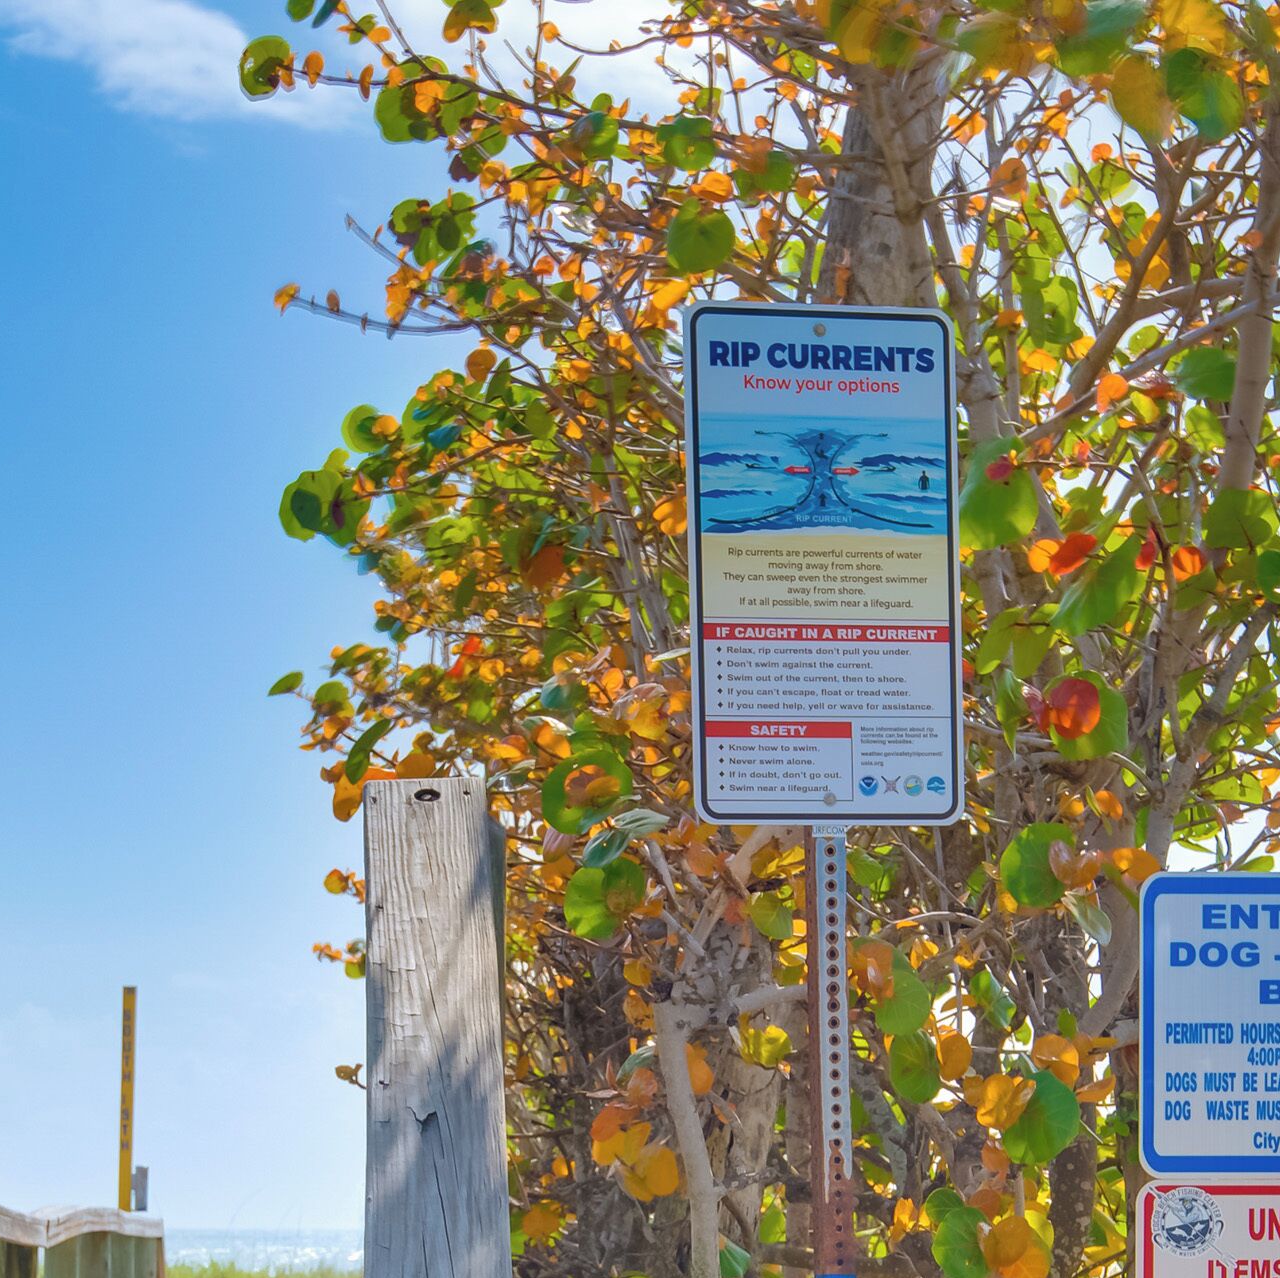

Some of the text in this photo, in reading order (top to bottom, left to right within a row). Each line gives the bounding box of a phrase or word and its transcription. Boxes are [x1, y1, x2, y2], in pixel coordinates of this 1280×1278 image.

[709, 340, 934, 373] RIP CURRENTS
[744, 374, 899, 395] Know your options
[728, 547, 743, 557] Rip
[745, 549, 783, 557] currents
[802, 549, 842, 559] powerful
[845, 551, 883, 559] currents
[896, 552, 921, 560] water
[768, 560, 882, 572] moving away from shore.
[722, 572, 745, 582] They
[766, 574, 796, 583] sweep
[822, 574, 837, 583] the
[840, 575, 882, 584] strongest
[885, 574, 927, 583] swimmer
[787, 586, 865, 596] away from shore.
[772, 597, 913, 609] possible, swim near lifeguard.
[716, 627, 937, 640] IF CAUGHT IN A RIP CURRENT
[726, 646, 912, 657] Relax, rip currents don't pull you under.
[727, 660, 751, 668] Don't
[782, 661, 816, 670] against
[819, 661, 833, 669] the
[727, 674, 752, 682] Swim
[785, 674, 800, 682] the
[803, 675, 839, 684] current,
[842, 675, 862, 683] then
[878, 675, 906, 683] shore.
[736, 689, 753, 697] you
[756, 688, 779, 696] can't
[856, 689, 880, 697] tread
[736, 703, 753, 711] you
[757, 702, 779, 710] need
[782, 702, 804, 711] help,
[808, 702, 824, 711] yell
[882, 703, 934, 711] assistance.
[750, 724, 806, 736] SAFETY
[729, 744, 819, 752] Know how swim.
[729, 757, 756, 765] Never
[786, 758, 814, 766] alone.
[749, 771, 779, 780] doubt,
[782, 771, 806, 779] don't
[729, 784, 754, 792] Swim
[788, 784, 832, 793] lifeguard.
[1170, 941, 1259, 967] DOG
[1166, 1022, 1233, 1044] PERMITTED
[1166, 1072, 1196, 1091] DOGS
[1204, 1072, 1235, 1091] MUST
[1243, 1072, 1257, 1091] BE
[1165, 1100, 1190, 1120] DOG
[1206, 1100, 1248, 1120] WASTE
[1253, 1132, 1280, 1153] City
[1177, 1188, 1204, 1199] FISHING
[1204, 1194, 1222, 1218] CENTER
